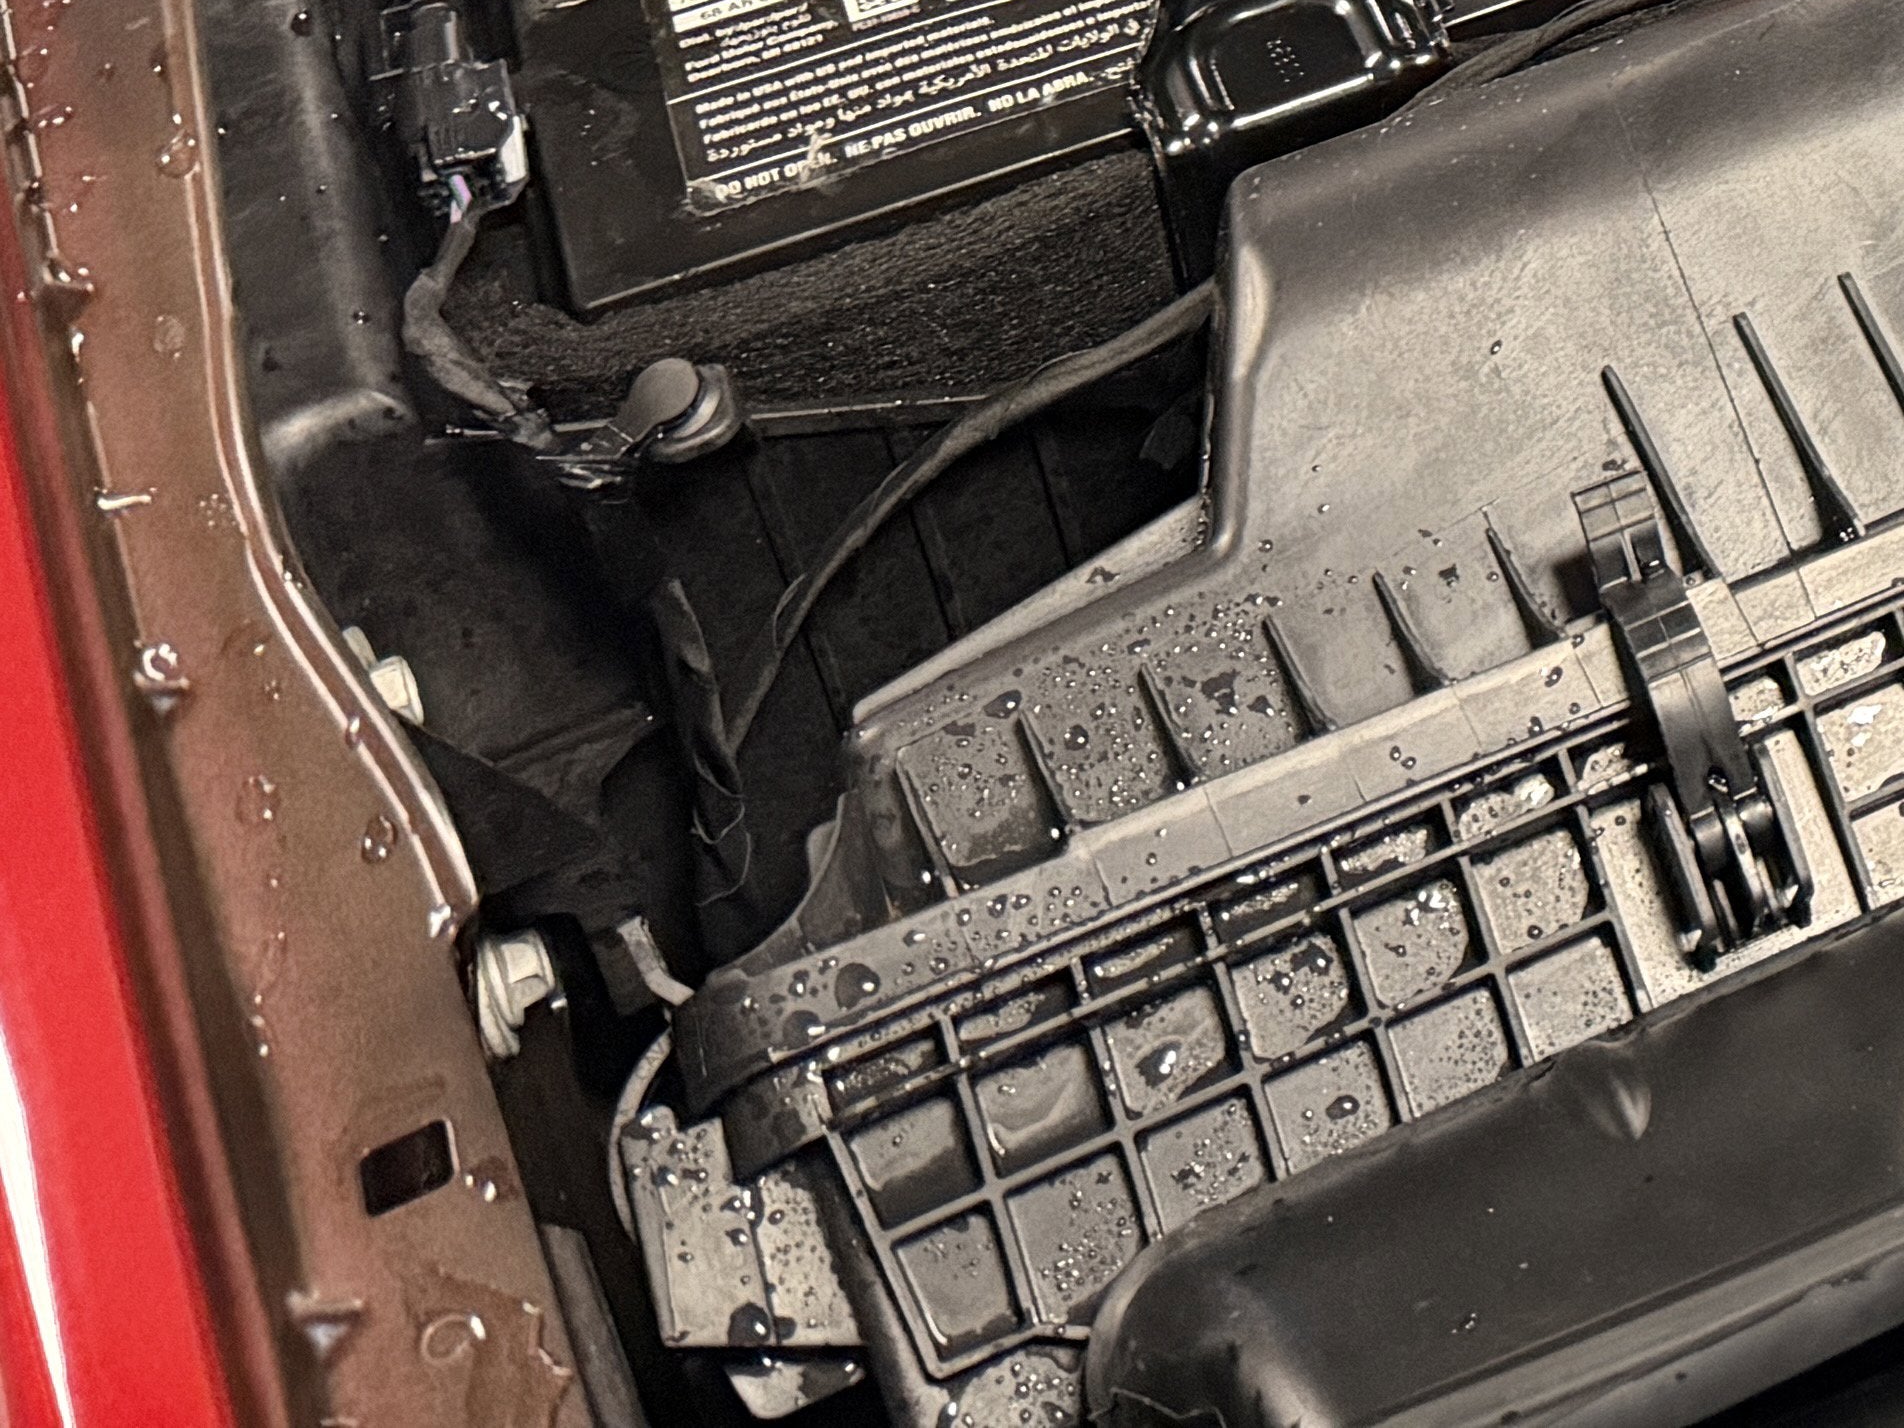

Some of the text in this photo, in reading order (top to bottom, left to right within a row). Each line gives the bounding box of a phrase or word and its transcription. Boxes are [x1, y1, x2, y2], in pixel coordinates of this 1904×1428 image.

[729, 0, 752, 11] Ah
[713, 180, 741, 199] DO
[744, 168, 779, 189] NOT
[845, 140, 870, 157] NE
[870, 128, 906, 149] PAS
[908, 106, 981, 137] OUVRIR.
[988, 95, 1014, 111] NO
[1016, 88, 1040, 103] LA
[1042, 72, 1094, 96] ABRA.
